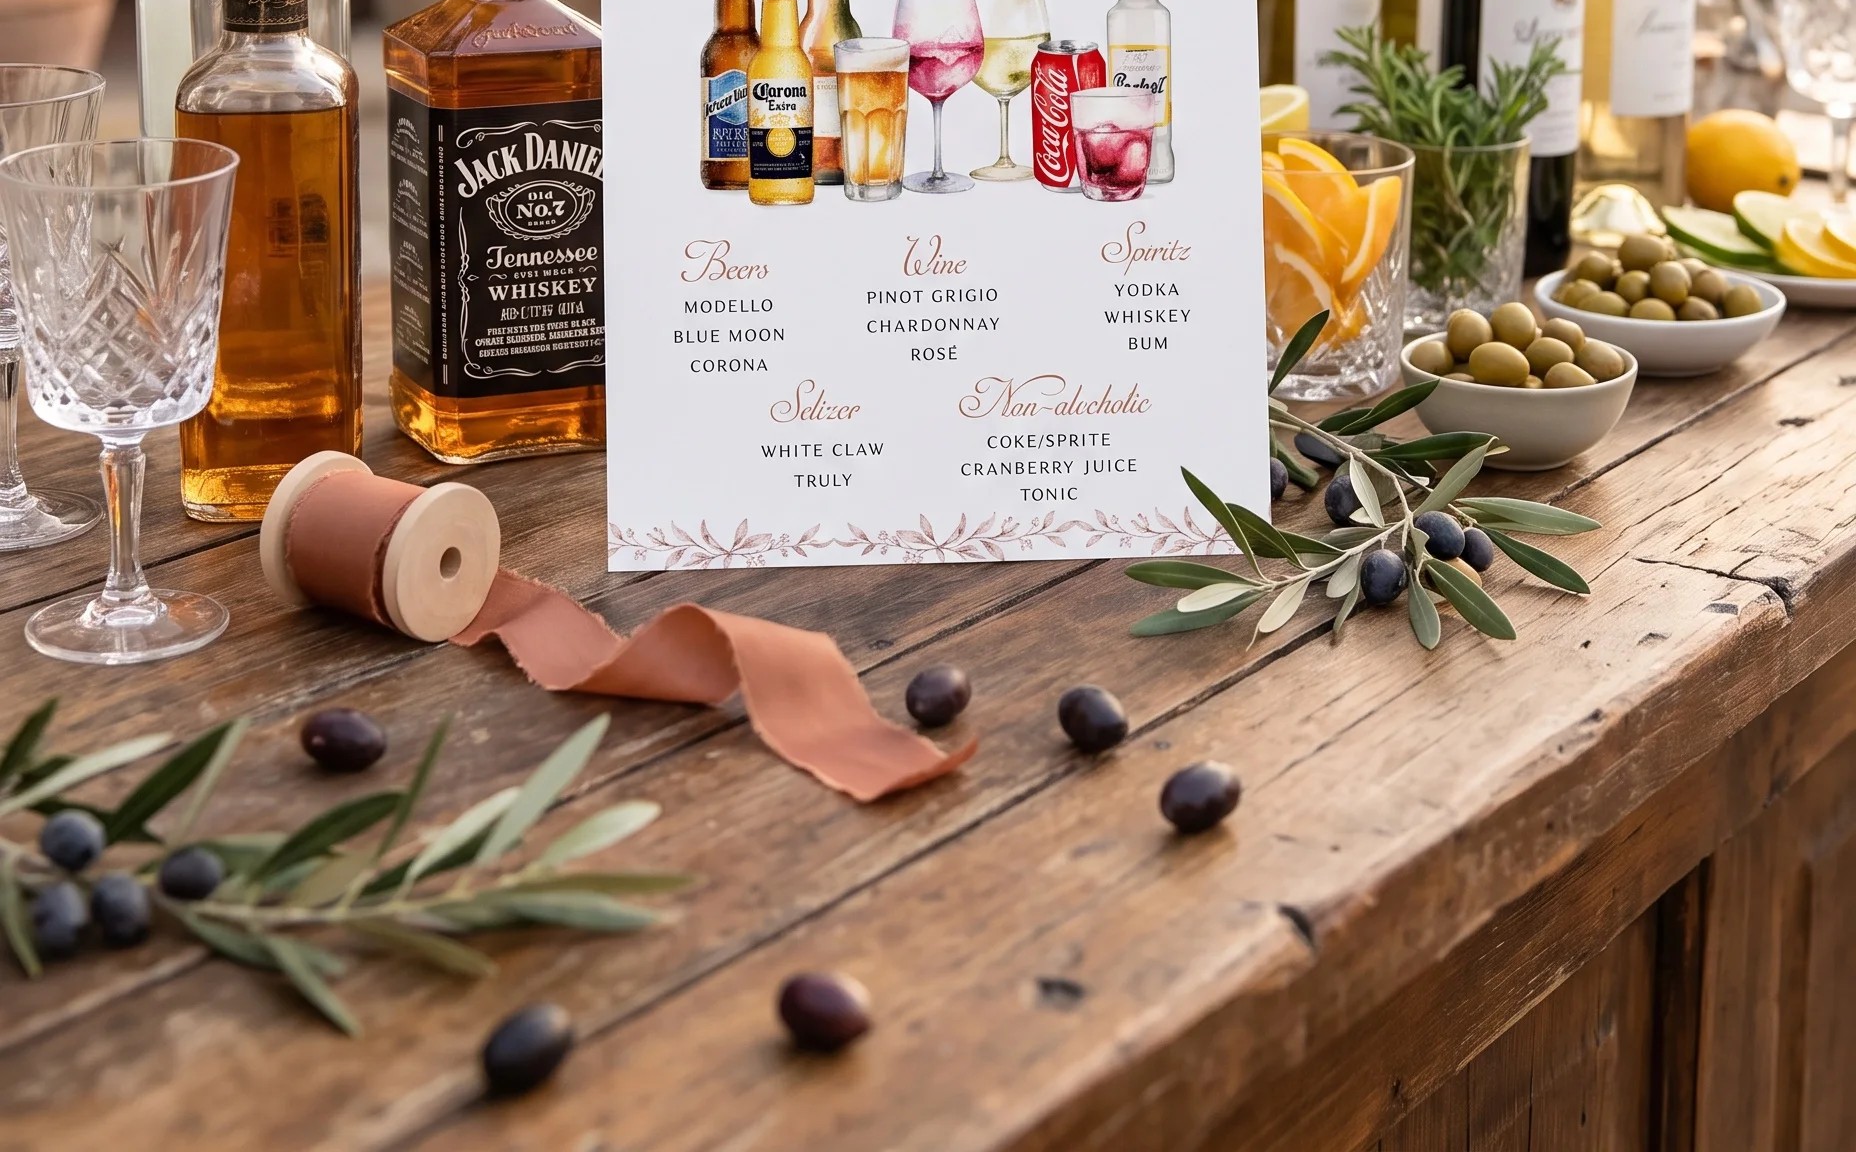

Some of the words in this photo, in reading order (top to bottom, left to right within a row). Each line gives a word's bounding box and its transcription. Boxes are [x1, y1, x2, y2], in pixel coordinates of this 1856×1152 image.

[454, 143, 524, 198] JACK
[486, 245, 599, 270] Tennessee
[680, 239, 770, 283] Beers
[903, 234, 968, 277] Wine
[487, 277, 598, 302] WHISKEY
[866, 290, 924, 305] PINOT
[931, 288, 998, 303] GRIGIO
[684, 298, 774, 314] MODELLO
[1103, 309, 1191, 324] WHISKEY
[866, 317, 1000, 334] CHARDONNAY
[673, 329, 720, 344] BLUE
[728, 327, 785, 343] MOON
[911, 344, 958, 362] ROSÉ
[690, 358, 769, 374] CORONA
[986, 432, 1111, 450] COKE/SPRITE
[760, 443, 823, 458] WHITE
[831, 442, 884, 457] CLAW
[960, 460, 1074, 477] CRANBERRY
[1083, 458, 1138, 476] JUICE
[793, 473, 853, 488] TRULY
[1019, 486, 1078, 502] TONIC
